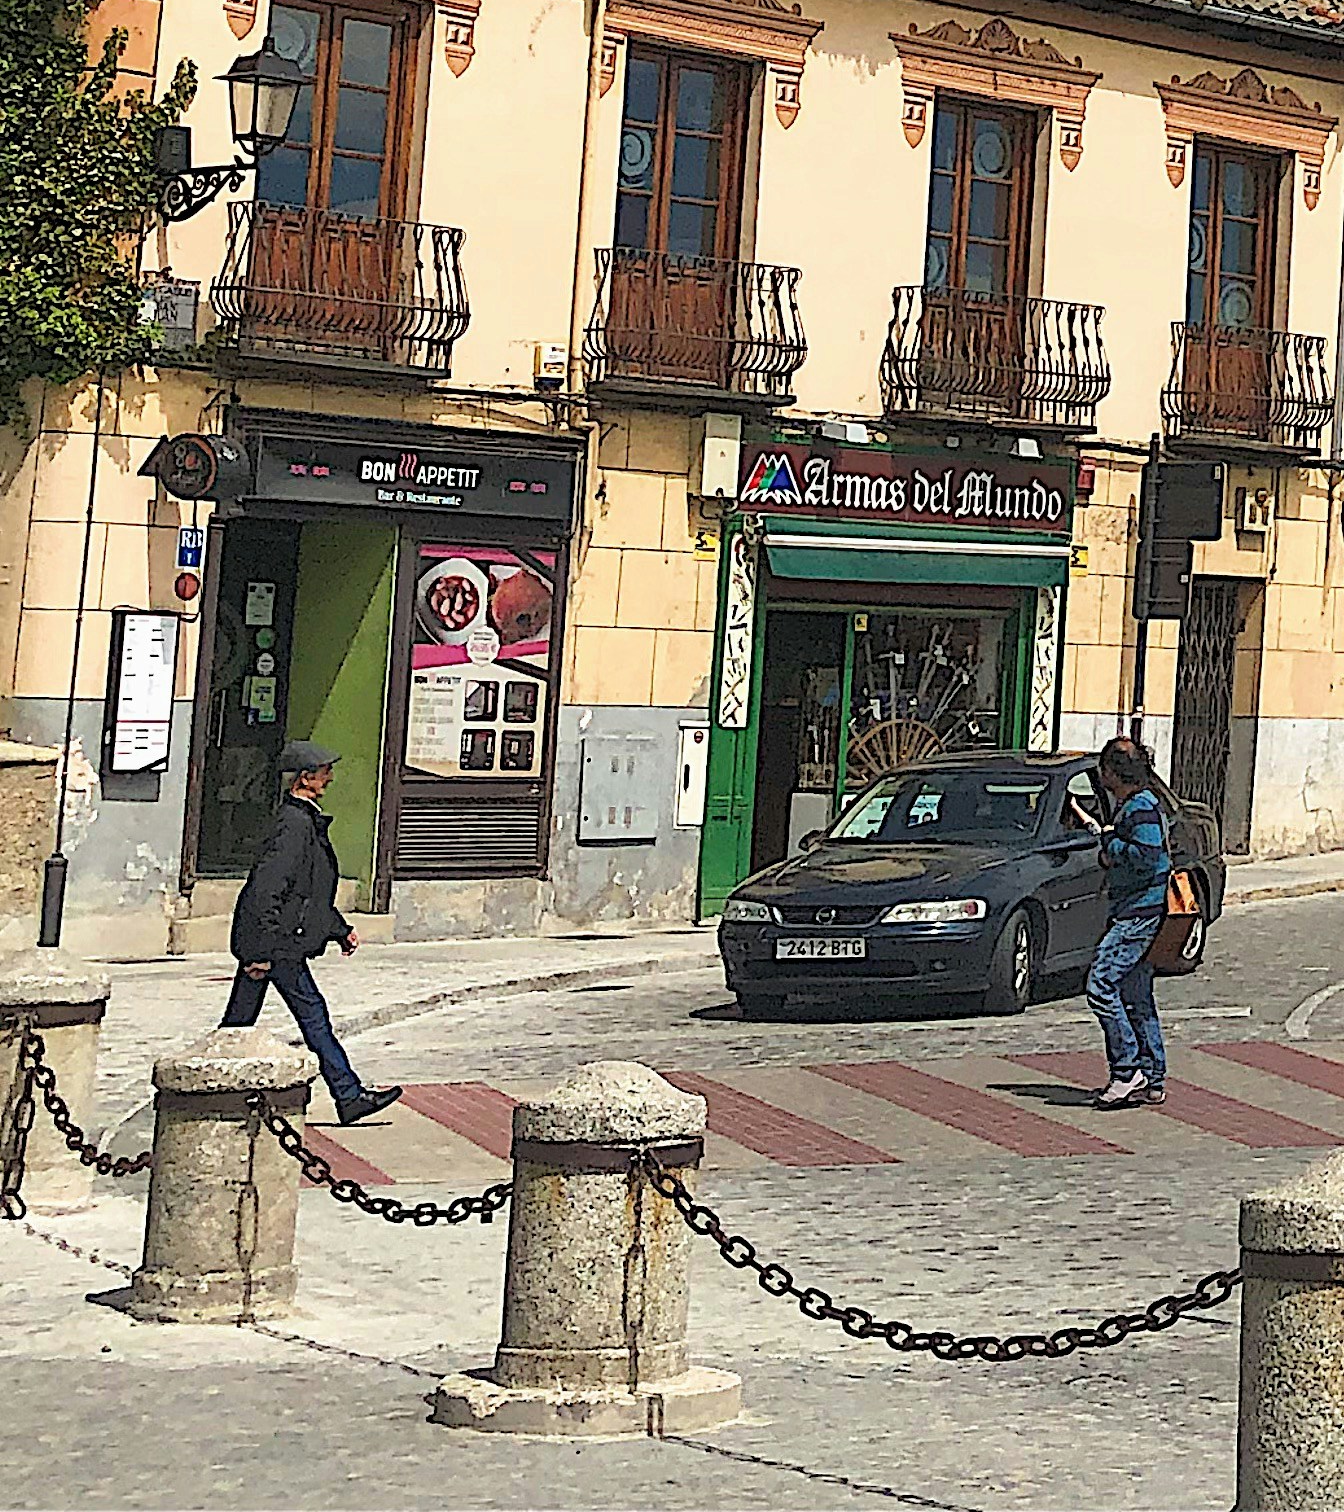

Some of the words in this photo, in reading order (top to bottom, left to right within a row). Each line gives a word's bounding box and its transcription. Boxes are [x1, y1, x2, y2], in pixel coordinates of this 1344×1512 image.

[361, 461, 396, 482] BON
[416, 466, 479, 487] APPETIT
[378, 489, 395, 501] Bar
[803, 457, 907, 512] Armas
[912, 470, 952, 515] del
[955, 471, 1063, 521] Mundo
[787, 940, 827, 956] 2412
[831, 940, 862, 955] BTG
